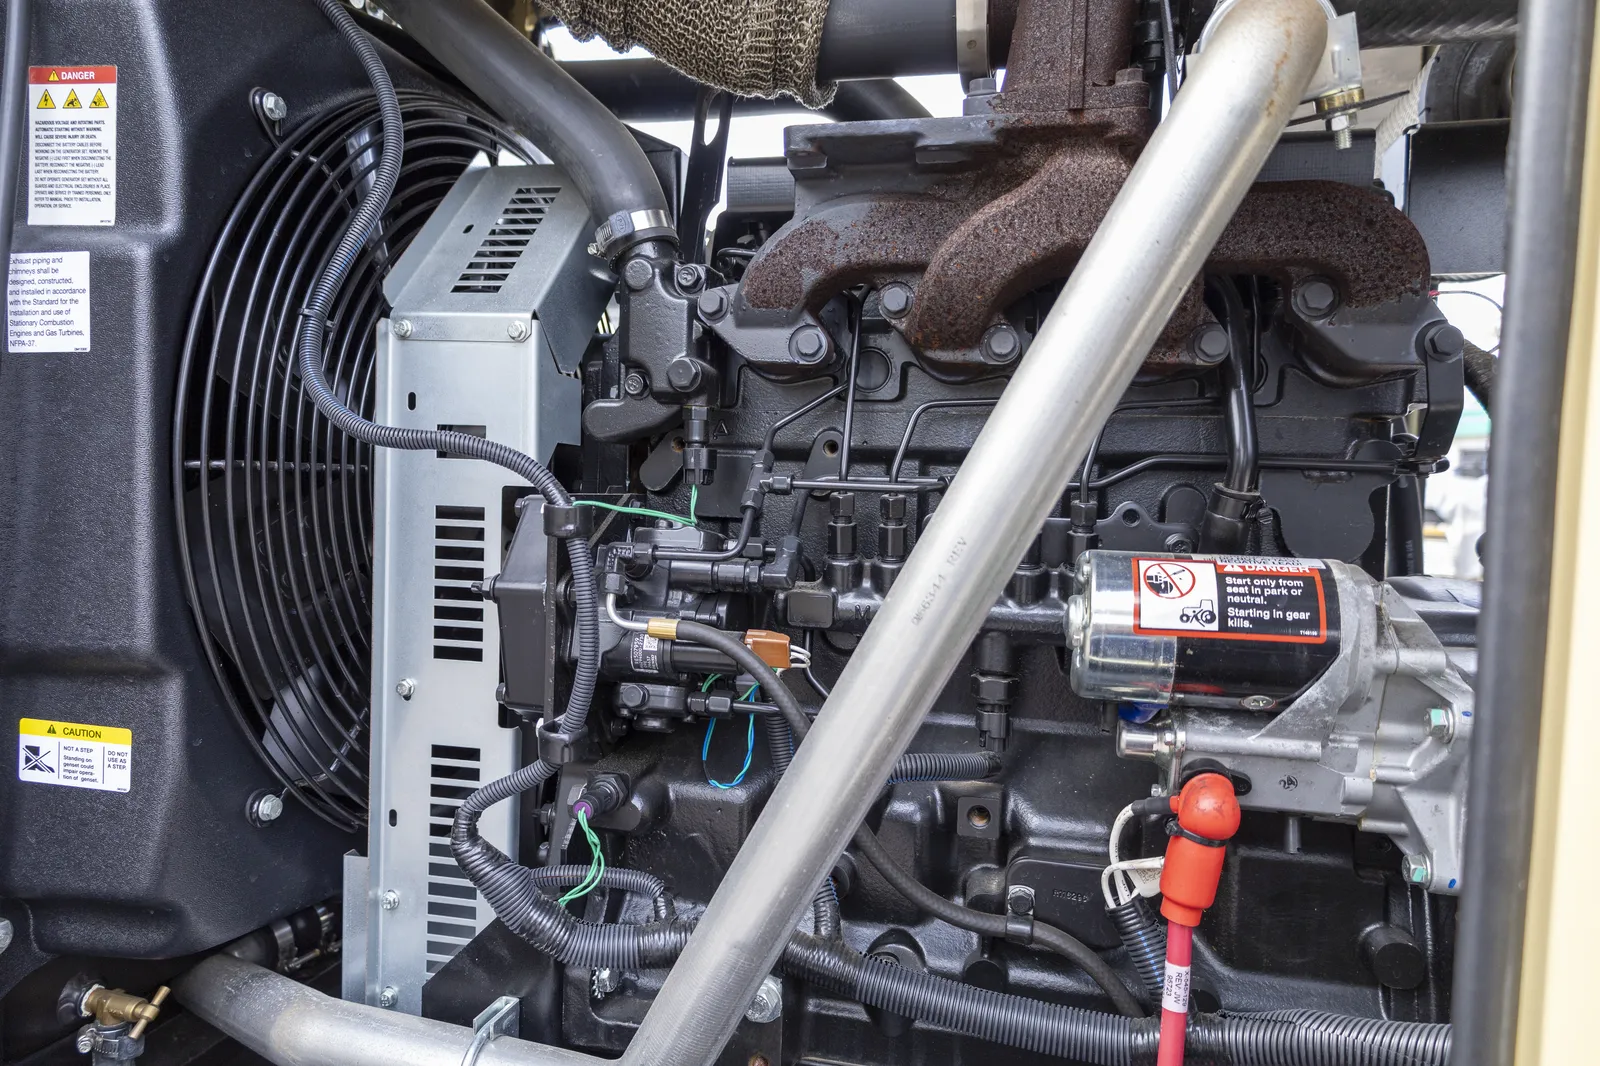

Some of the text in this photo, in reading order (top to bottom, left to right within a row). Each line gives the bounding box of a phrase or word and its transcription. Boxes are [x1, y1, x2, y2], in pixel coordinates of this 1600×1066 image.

[61, 71, 95, 80] DANGER
[32, 257, 50, 265] piping
[38, 277, 74, 285] constructed,
[10, 330, 32, 338] Engines
[1245, 564, 1310, 573] DANGER
[1225, 576, 1304, 588] Start only from
[1226, 586, 1248, 594] seat
[1252, 586, 1262, 595] in
[1264, 587, 1288, 597] park
[1227, 595, 1267, 605] neutral.
[1227, 608, 1311, 621] Starting in gear
[1228, 617, 1253, 628] kills.
[63, 727, 102, 739] CAUTION
[63, 755, 85, 763] Standing
[81, 776, 99, 784] genset.
